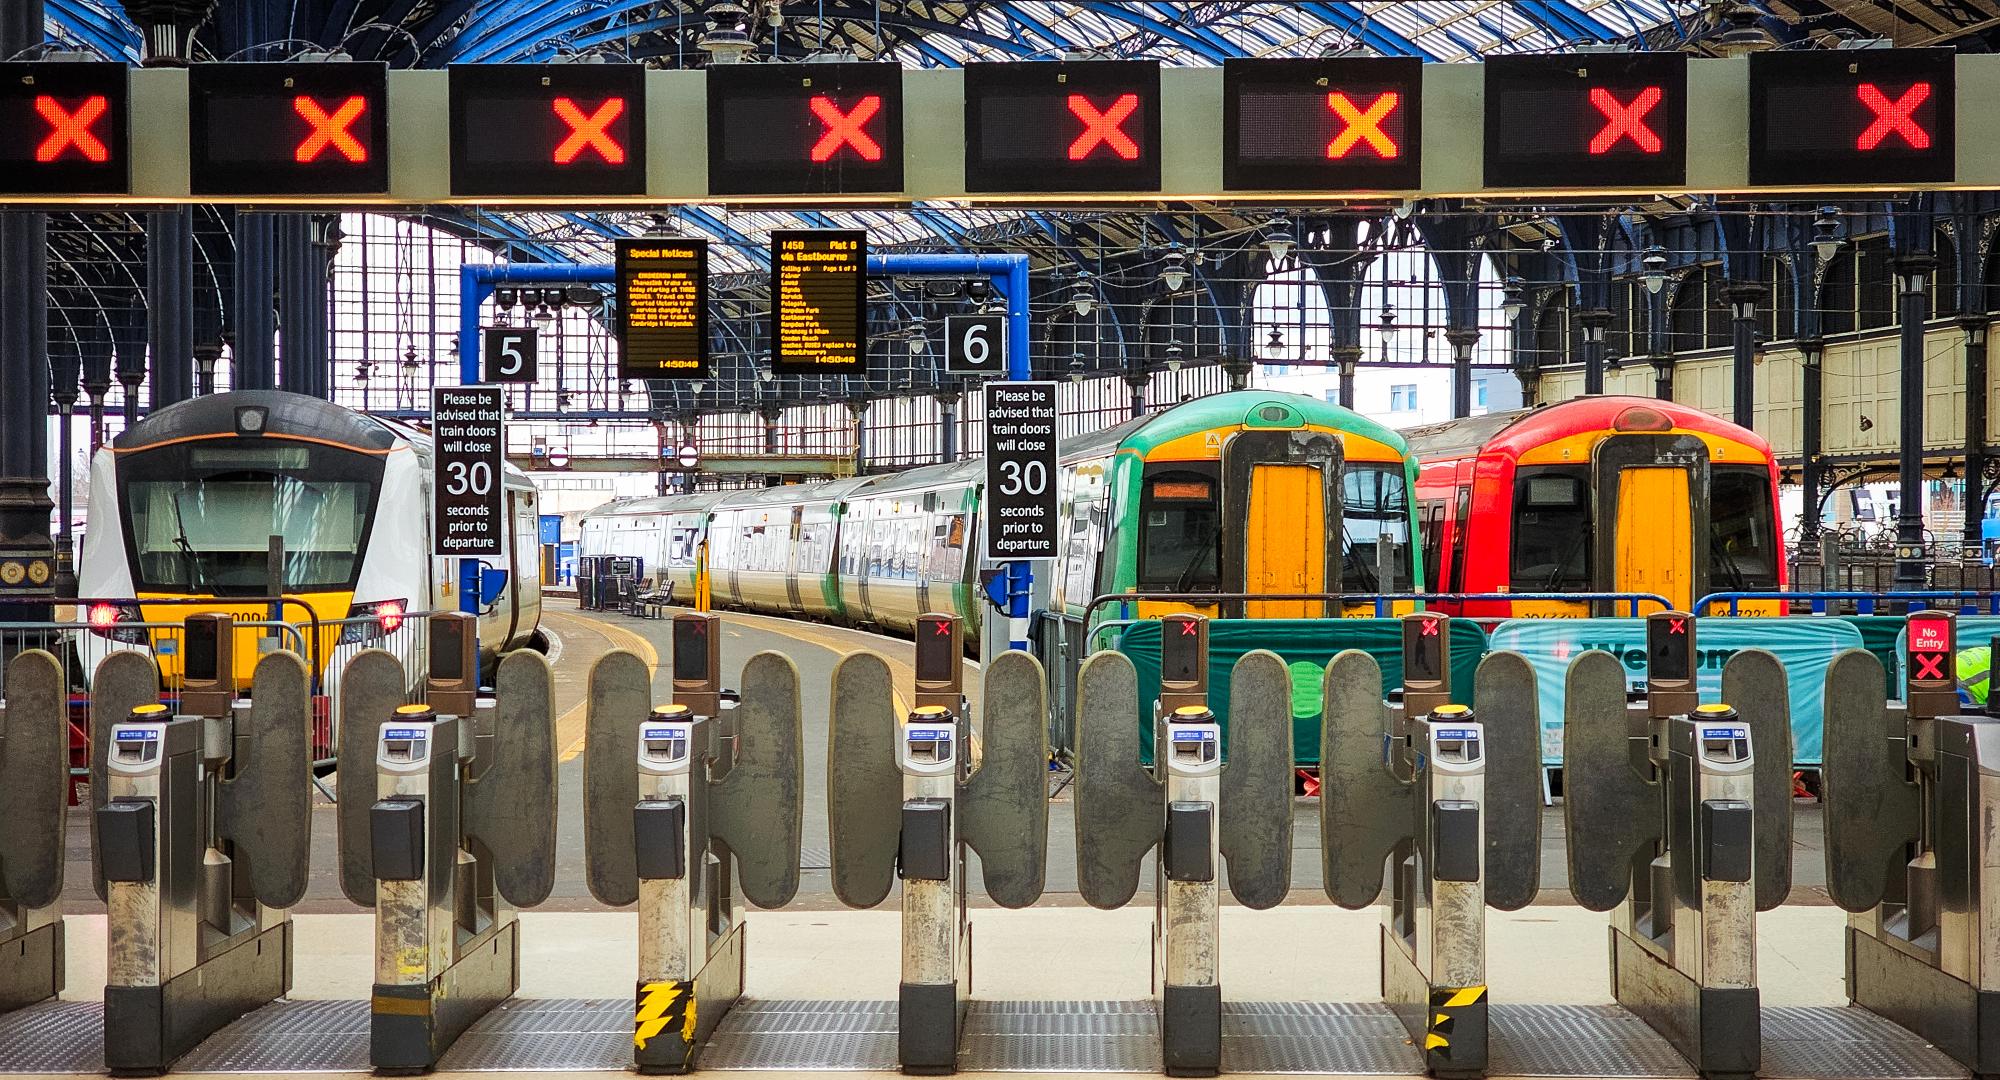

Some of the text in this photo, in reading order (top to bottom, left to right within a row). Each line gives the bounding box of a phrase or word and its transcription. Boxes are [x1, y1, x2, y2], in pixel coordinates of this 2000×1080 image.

[830, 241, 847, 250] Plat
[630, 249, 693, 258] Special Notices
[781, 252, 848, 261] via Eastbourne
[963, 324, 990, 364] 6
[500, 336, 522, 375] 5
[443, 393, 492, 405] Please be
[995, 389, 1046, 402] Please be
[436, 409, 500, 420] advised that
[988, 406, 1054, 418] advised that
[440, 424, 496, 437] train doors
[992, 422, 1051, 435] train doors
[444, 440, 492, 452] will close
[996, 439, 1046, 451] will close
[446, 461, 492, 496] 30
[1000, 460, 1047, 496] 30
[447, 504, 489, 516] seconds
[1000, 504, 1045, 517] seconds
[449, 520, 488, 534] prior to
[1003, 522, 1043, 536] prior to
[443, 536, 494, 550] departure
[996, 538, 1050, 552] departure
[1922, 628, 1937, 638] No
[1916, 638, 1944, 650] Entry
[939, 731, 949, 739] 57
